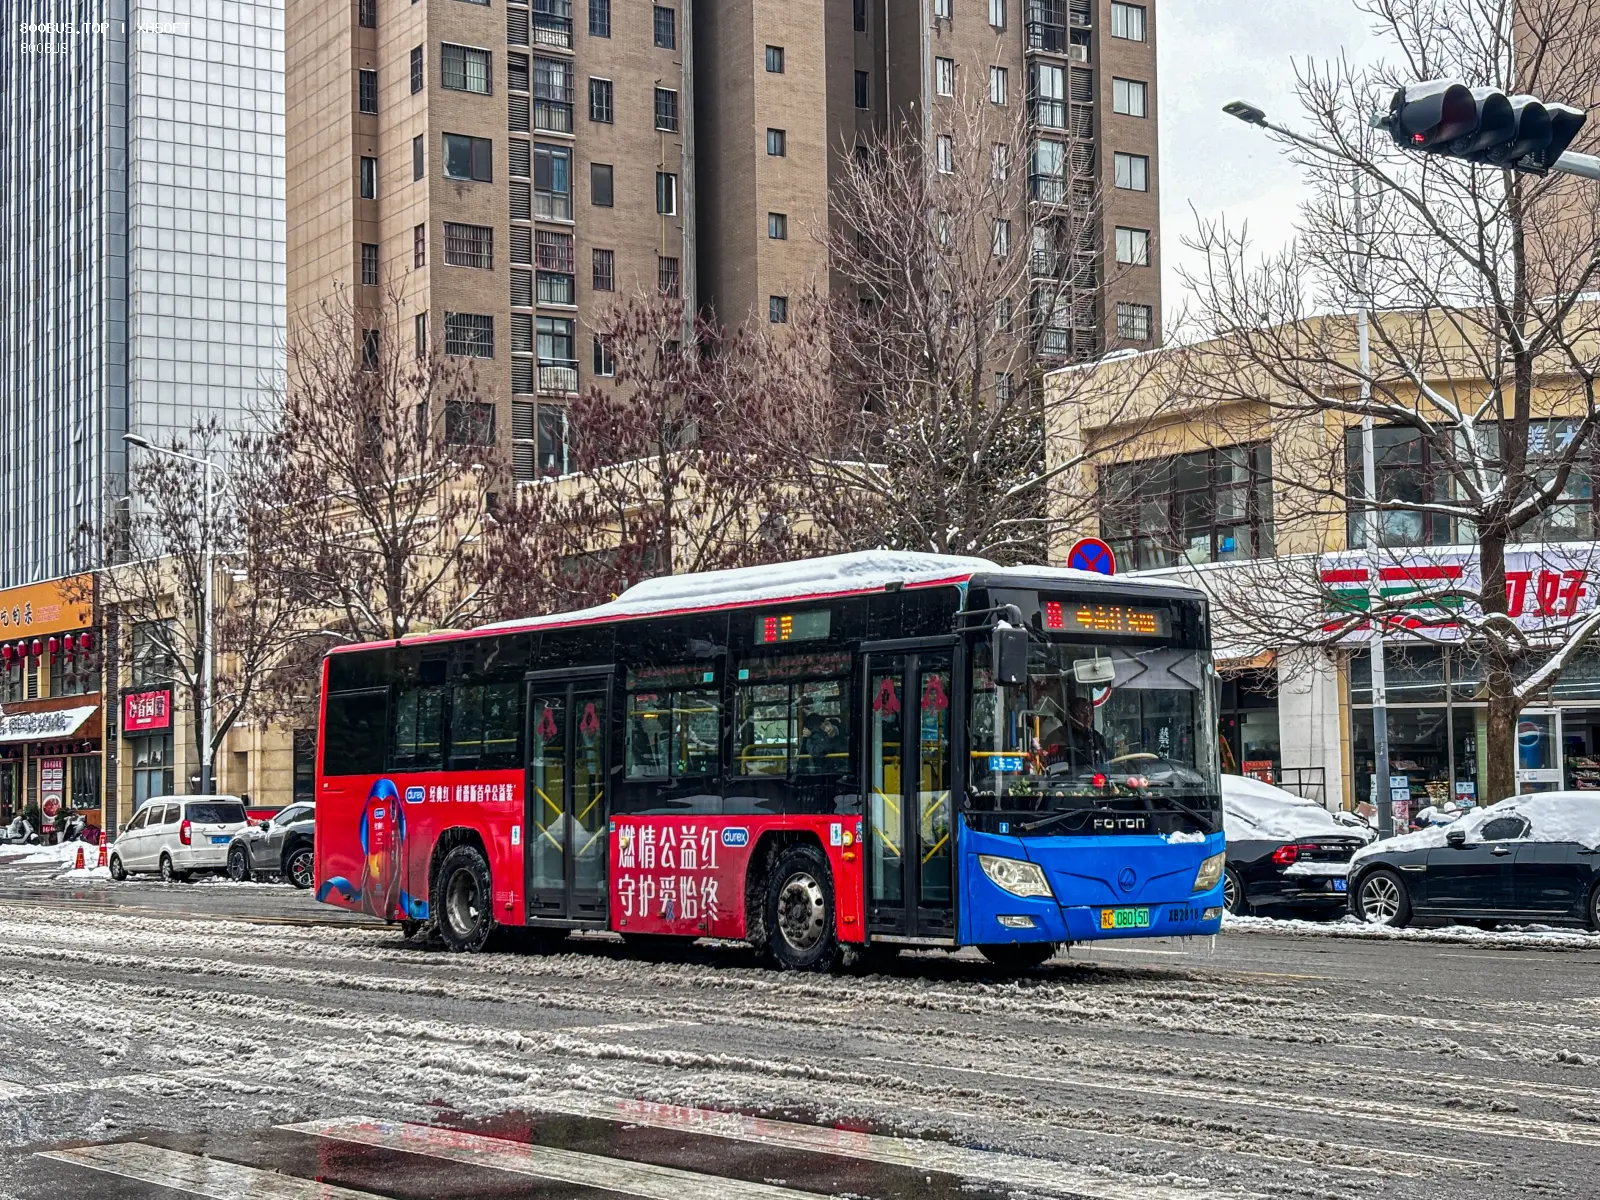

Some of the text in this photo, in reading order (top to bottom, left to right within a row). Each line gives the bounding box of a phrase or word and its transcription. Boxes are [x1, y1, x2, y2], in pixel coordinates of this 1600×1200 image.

[406, 789, 424, 801] durex
[429, 785, 450, 802] 经典红
[1093, 818, 1145, 829] FOTON
[618, 825, 747, 869] 燃情公益红 durex
